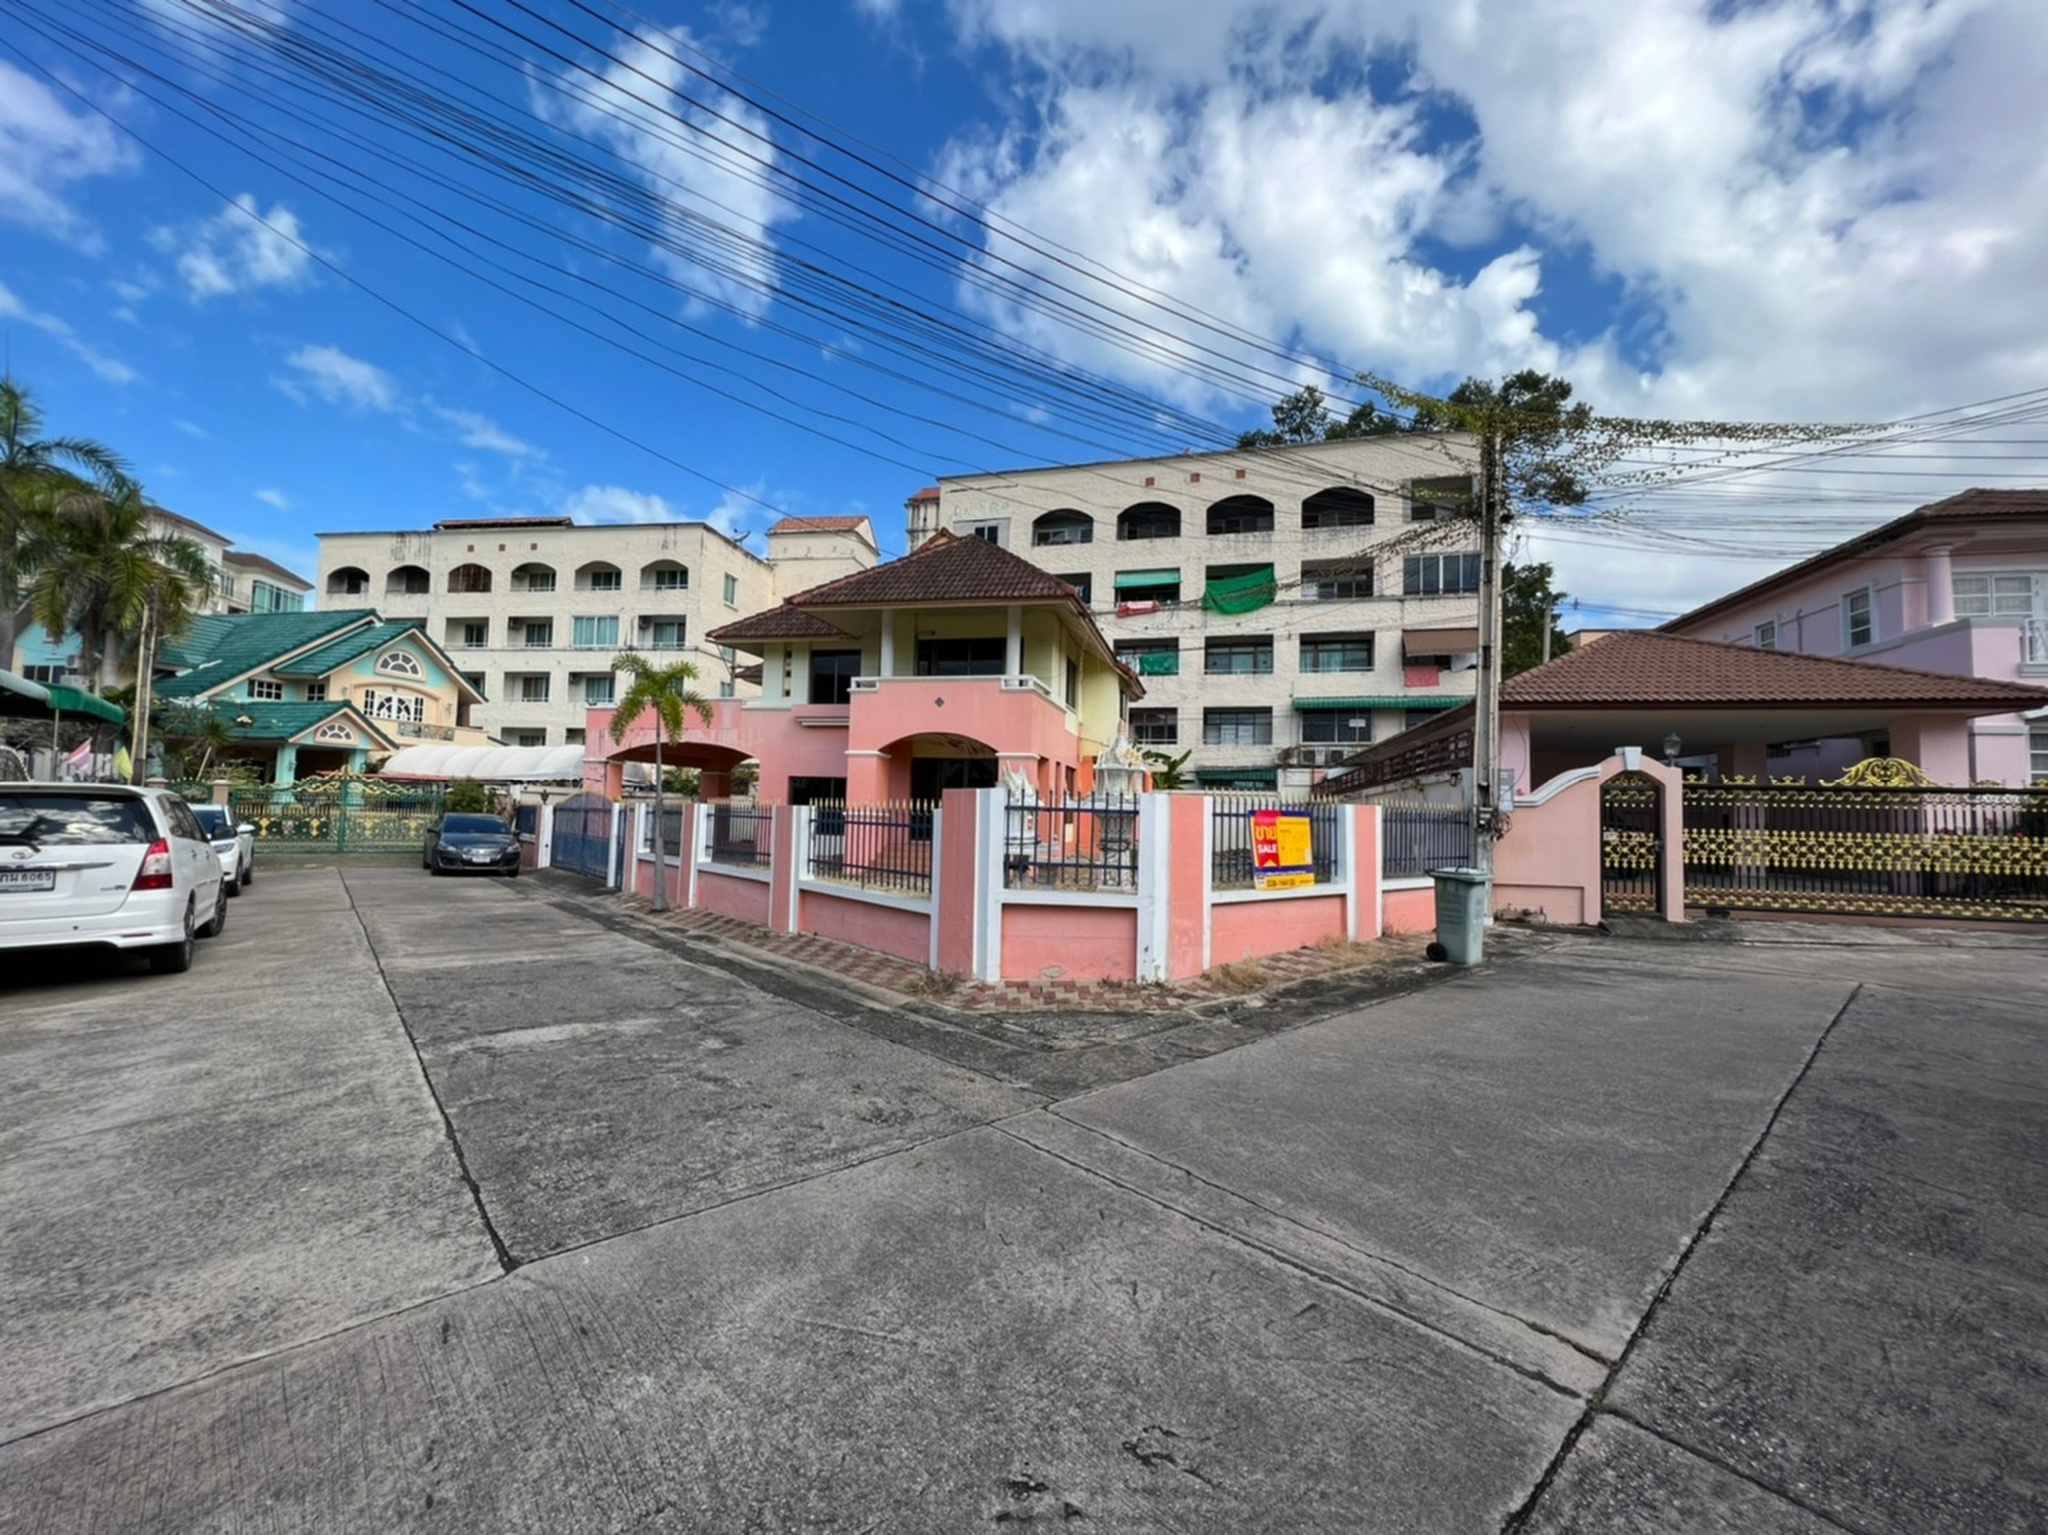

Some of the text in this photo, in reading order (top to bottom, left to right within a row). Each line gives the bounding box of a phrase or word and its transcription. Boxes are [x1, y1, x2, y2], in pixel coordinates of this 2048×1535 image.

[1256, 826, 1276, 840] ขาย
[1258, 844, 1277, 853] SALE
[21, 872, 52, 882] 6065
